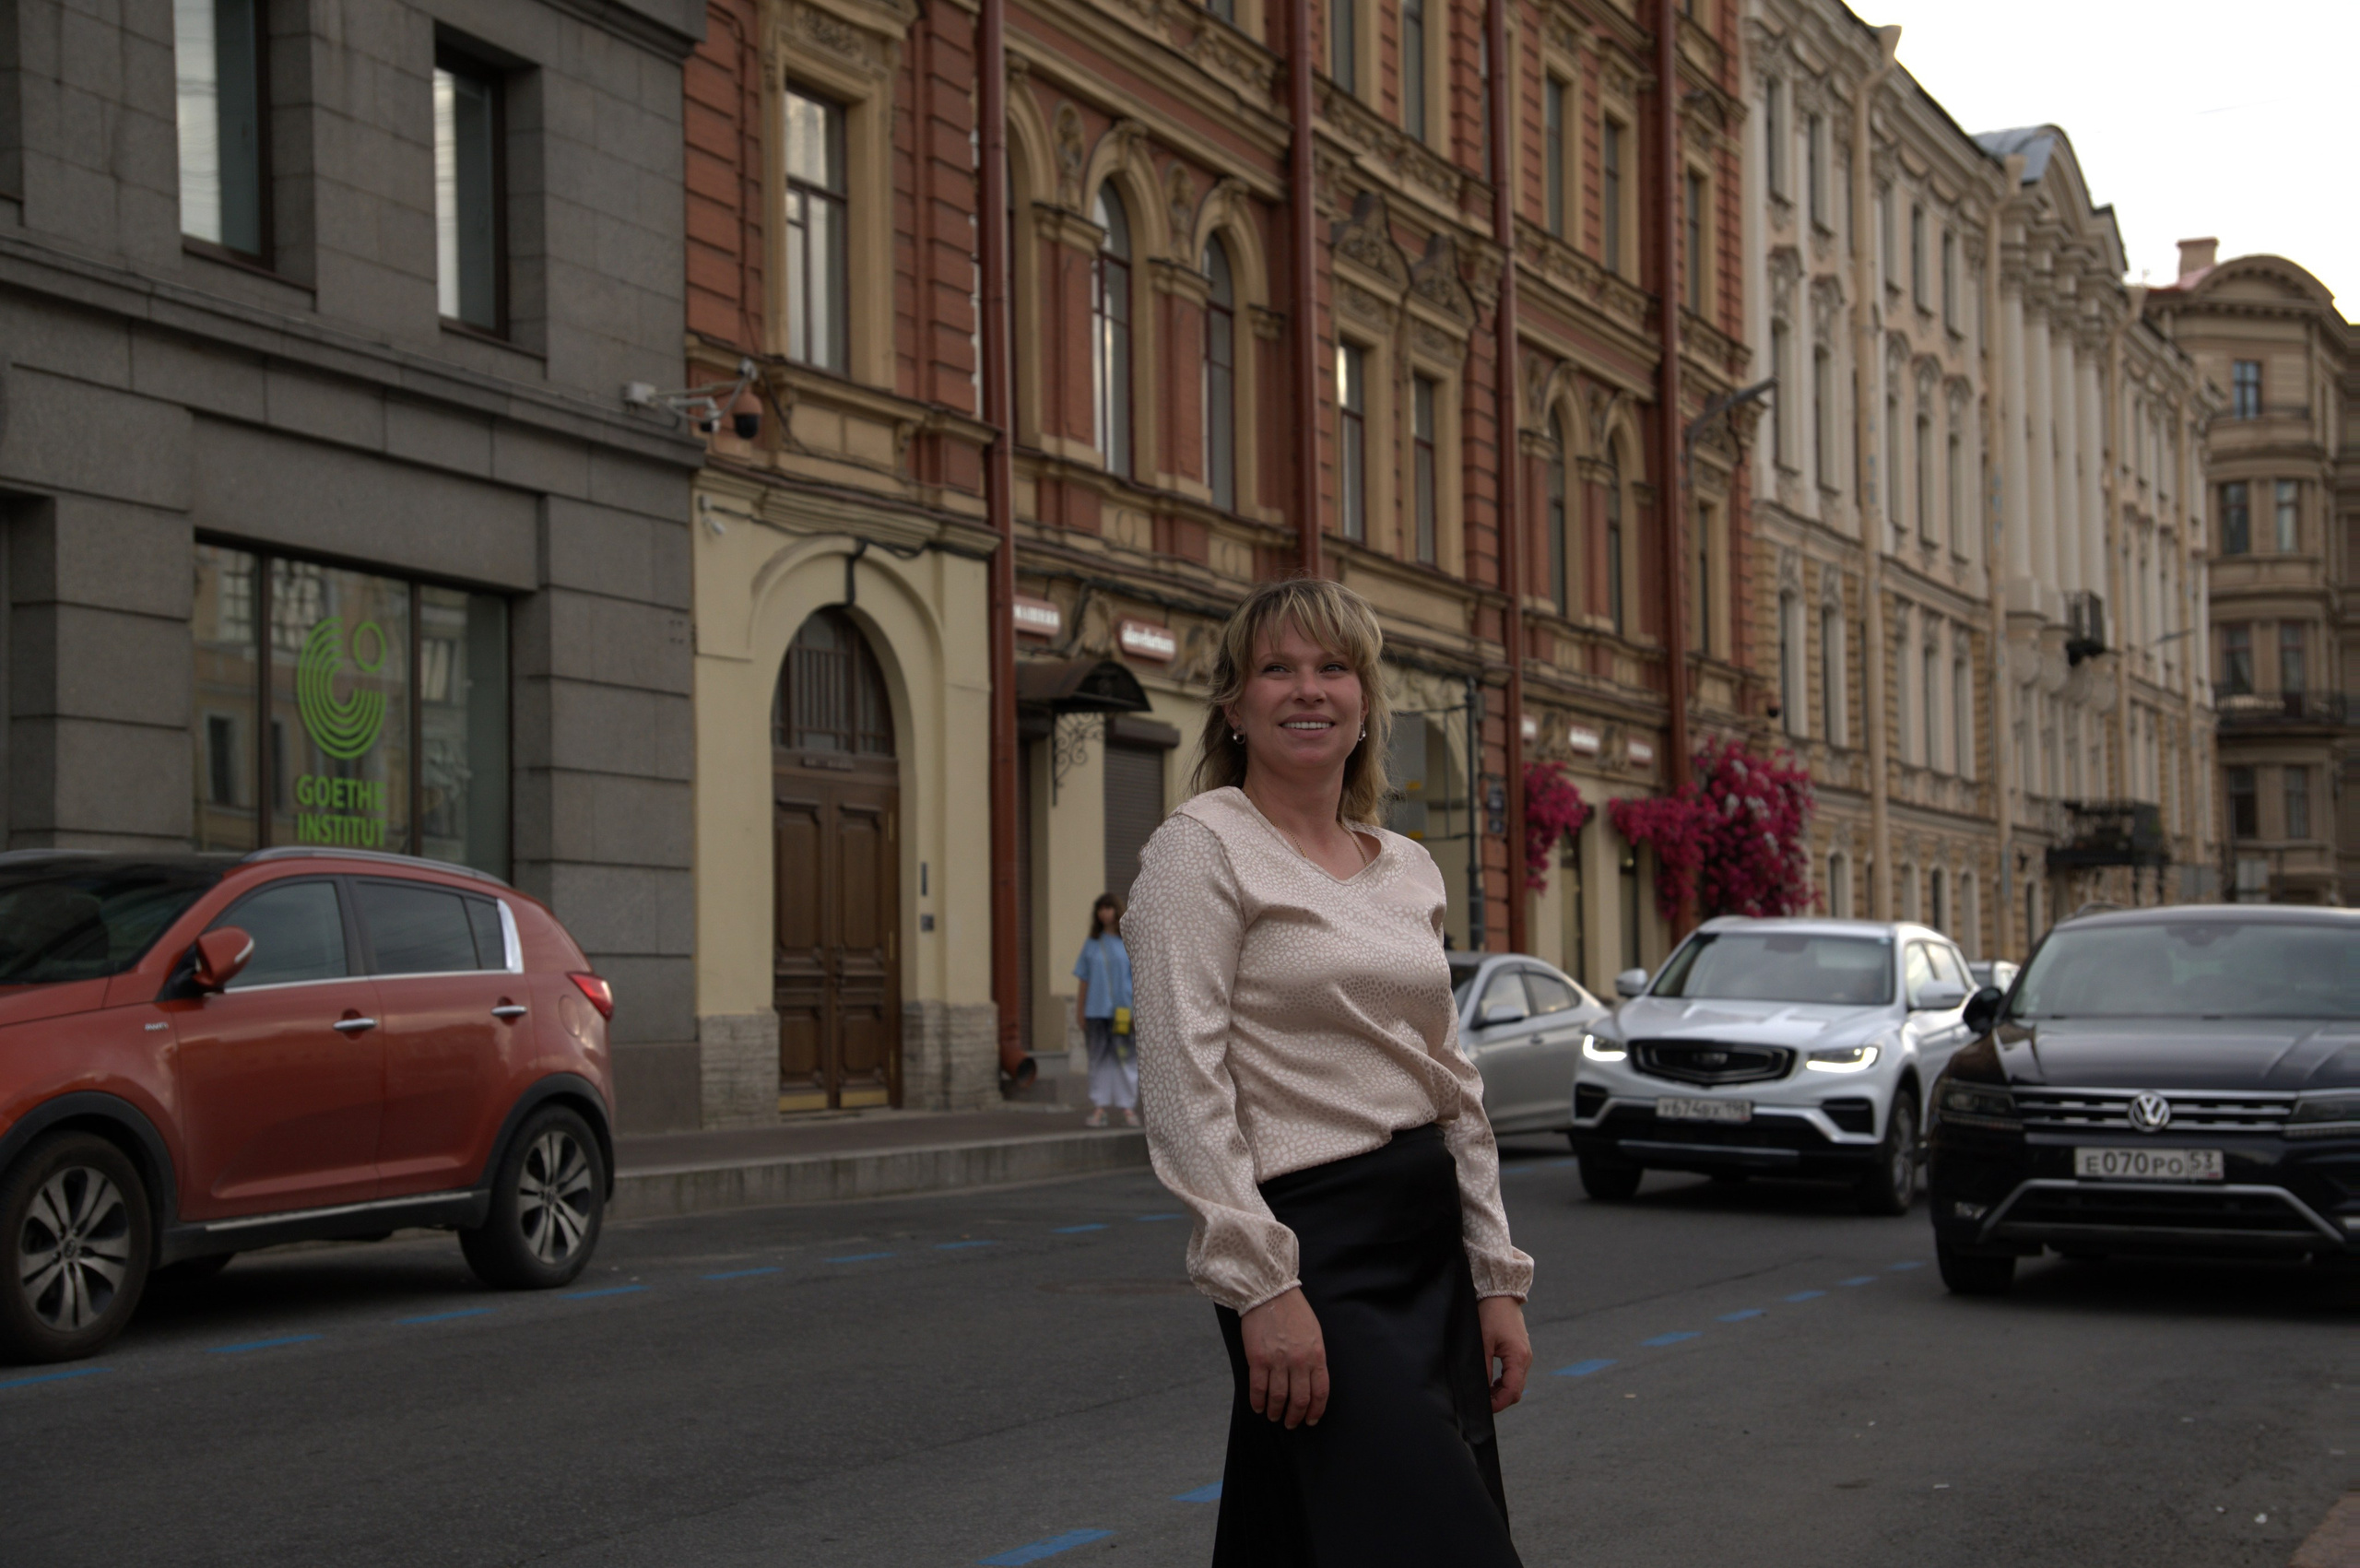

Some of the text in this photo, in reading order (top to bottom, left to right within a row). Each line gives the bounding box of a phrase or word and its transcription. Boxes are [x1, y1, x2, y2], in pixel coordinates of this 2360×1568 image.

[296, 774, 385, 811] GOETHE
[297, 813, 385, 847] INSTITUT
[2189, 1149, 2214, 1171] 53
